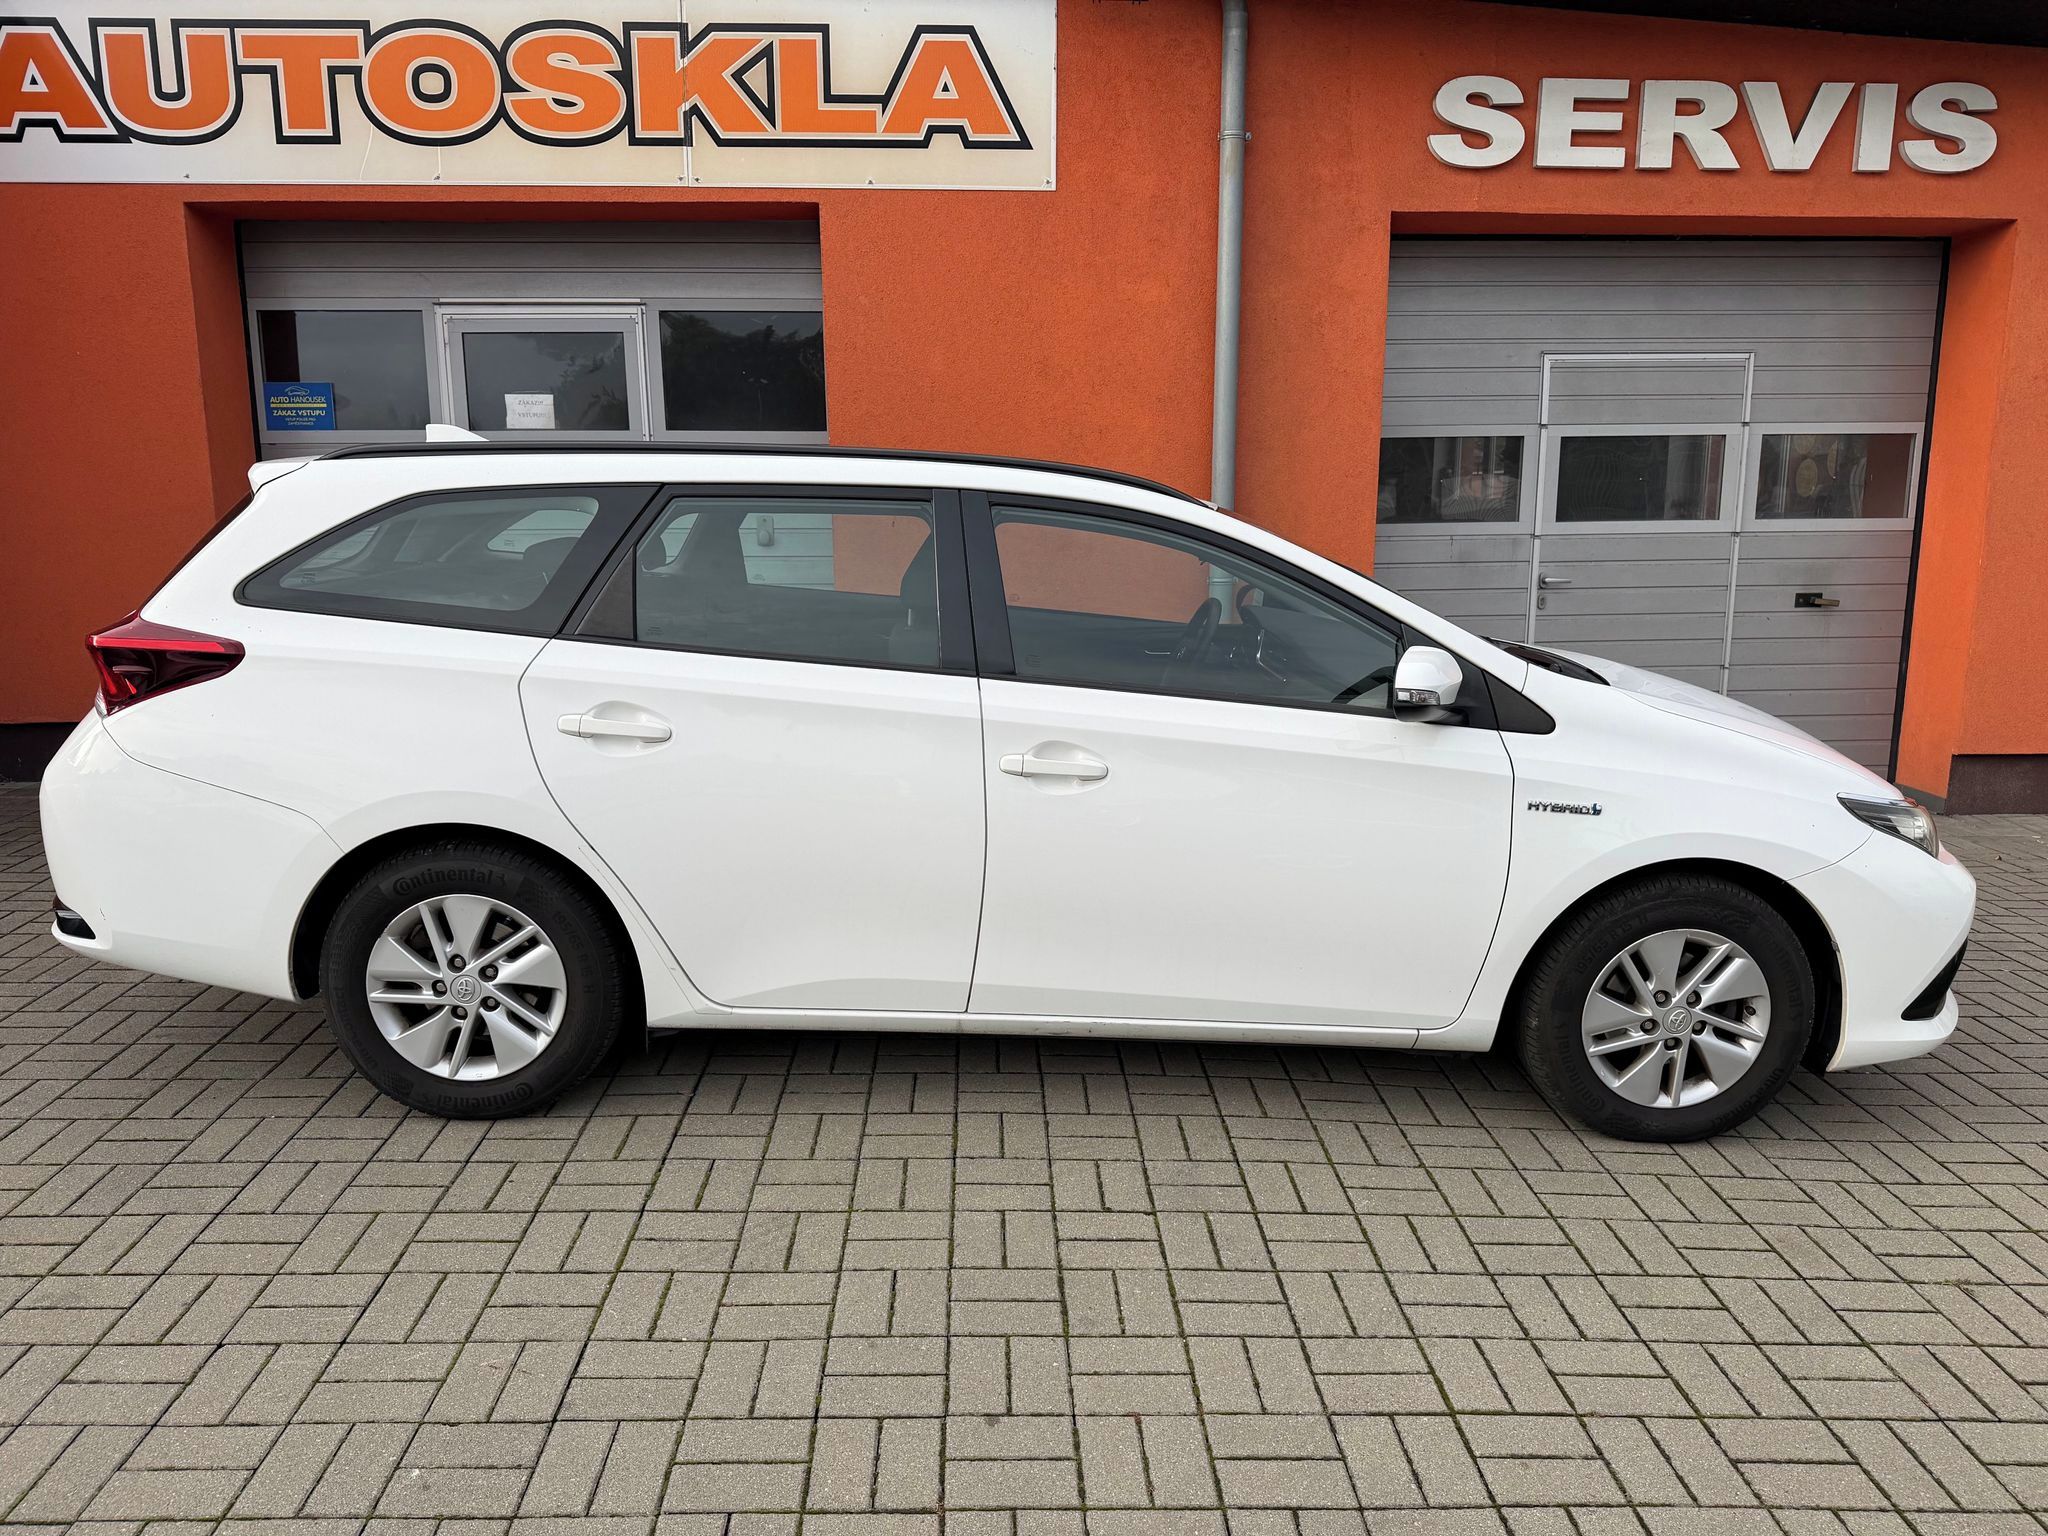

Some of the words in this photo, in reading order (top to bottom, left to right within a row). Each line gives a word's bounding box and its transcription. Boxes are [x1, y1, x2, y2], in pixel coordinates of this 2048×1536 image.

[0, 17, 1033, 149] AUTOSKLA
[1427, 75, 1998, 175] SERVIS
[1527, 801, 1590, 815] HYBRID
[392, 868, 494, 896] Continental
[1575, 934, 1609, 975] 195/65
